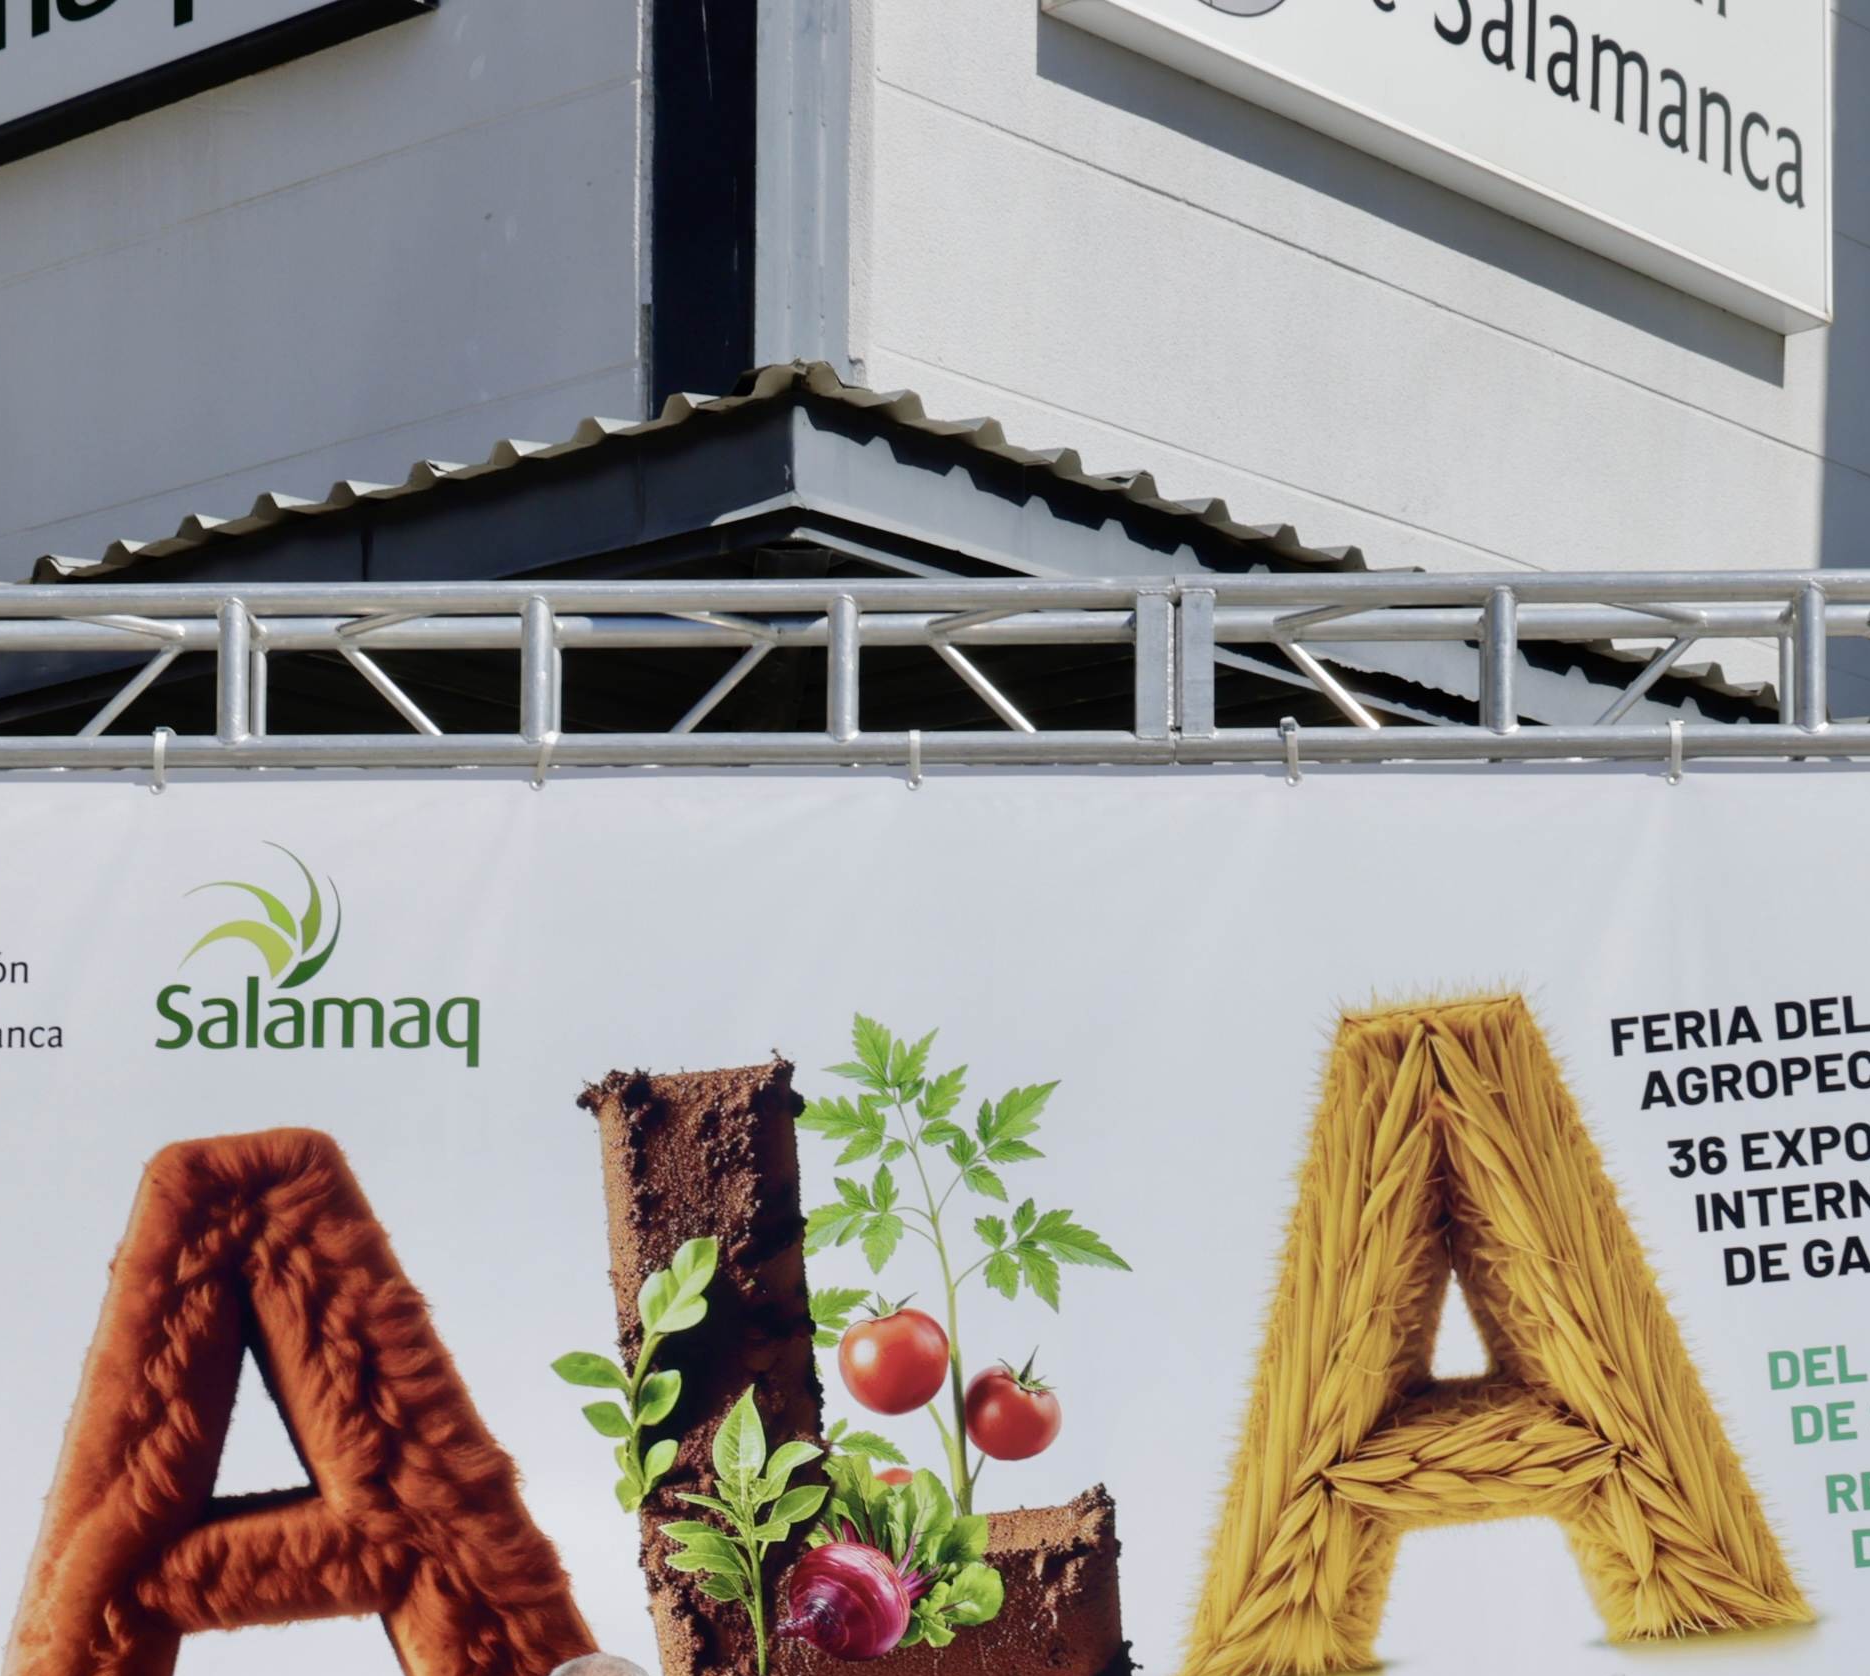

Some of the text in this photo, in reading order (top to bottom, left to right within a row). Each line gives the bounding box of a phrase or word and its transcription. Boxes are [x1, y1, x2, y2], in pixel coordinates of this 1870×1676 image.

[155, 976, 480, 1068] Salamaq
[1611, 1005, 1763, 1057] FERIA
[1667, 1136, 1728, 1178] 36
[1723, 1243, 1790, 1286] DE
[1768, 1345, 1867, 1390] DEL
[1791, 1401, 1857, 1444] DE
